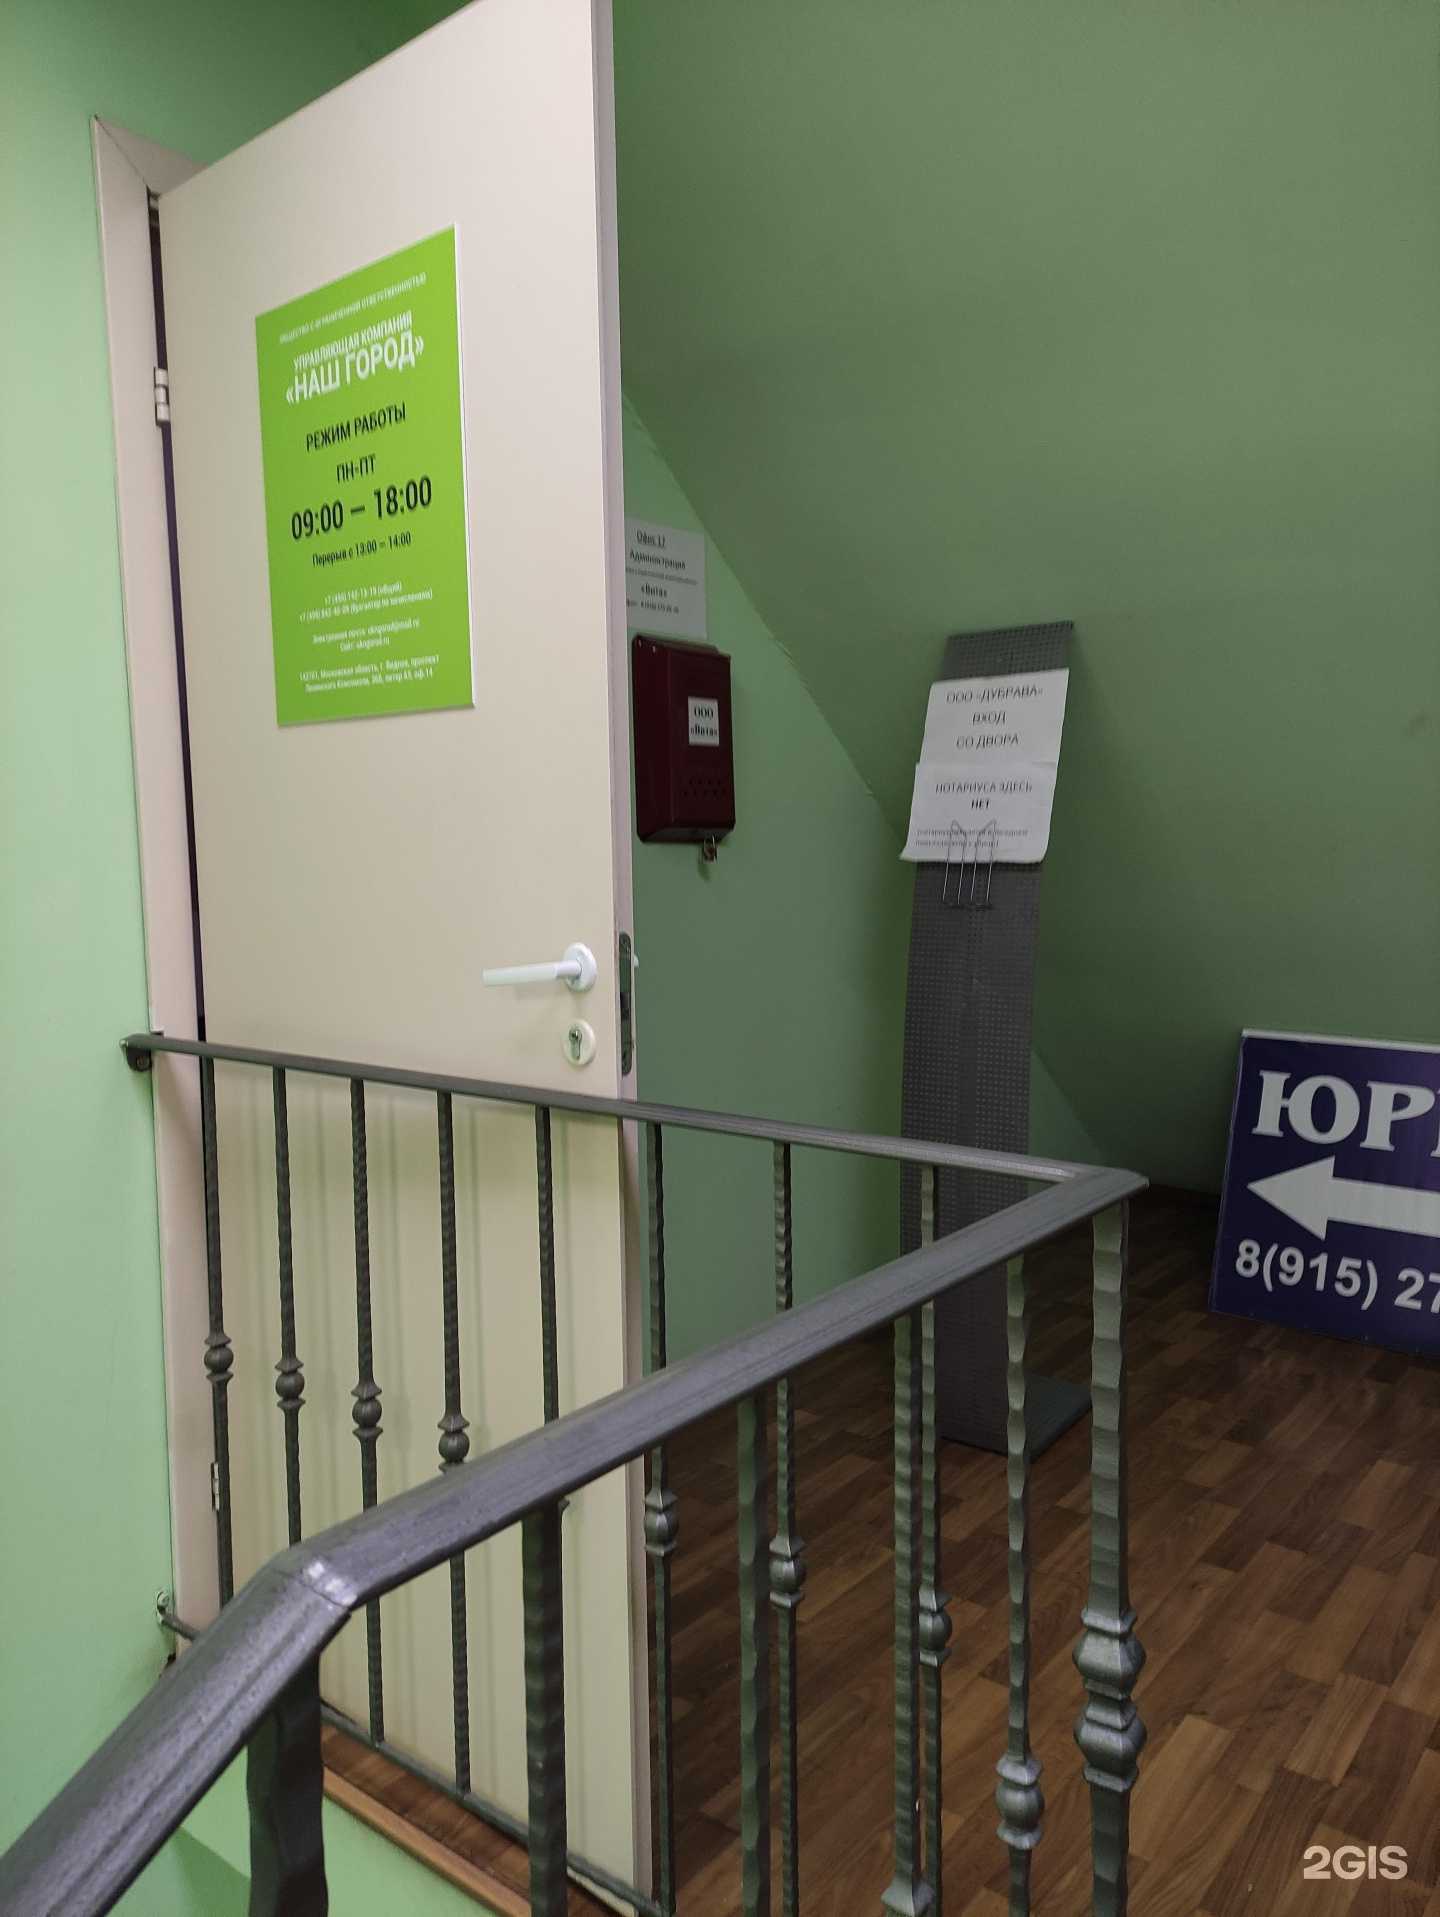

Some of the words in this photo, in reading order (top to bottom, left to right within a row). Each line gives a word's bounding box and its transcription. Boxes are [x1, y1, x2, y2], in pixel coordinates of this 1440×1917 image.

[294, 331, 360, 371] УПРАВЛЯЮЩАЯ
[361, 310, 413, 345] КОМПАНИЯ
[286, 360, 340, 404] «НАШ
[344, 331, 424, 384] ГОРОД»
[306, 424, 351, 453] РЕЖИМ
[354, 402, 406, 436] РАБОТЫ
[336, 454, 376, 483] ПН-ПТ
[291, 501, 344, 541] 09:00
[373, 475, 432, 519] 18:00
[312, 546, 347, 567] Перерыв
[355, 536, 377, 557] 13:00
[387, 531, 411, 553] 14:00
[630, 549, 686, 569] Администрация
[945, 689, 973, 704] ООО
[976, 685, 1043, 704] «ДУБРАВА»
[694, 706, 714, 719] ООО
[971, 709, 1007, 726] ВХОД
[955, 735, 974, 749] СО
[975, 733, 1019, 750] ДВОРА
[935, 781, 997, 794] НОТАРИУСА
[970, 798, 991, 809] НЕТ
[1252, 1070, 1440, 1158] ЮР
[1235, 1239, 1378, 1311] 8(915)
